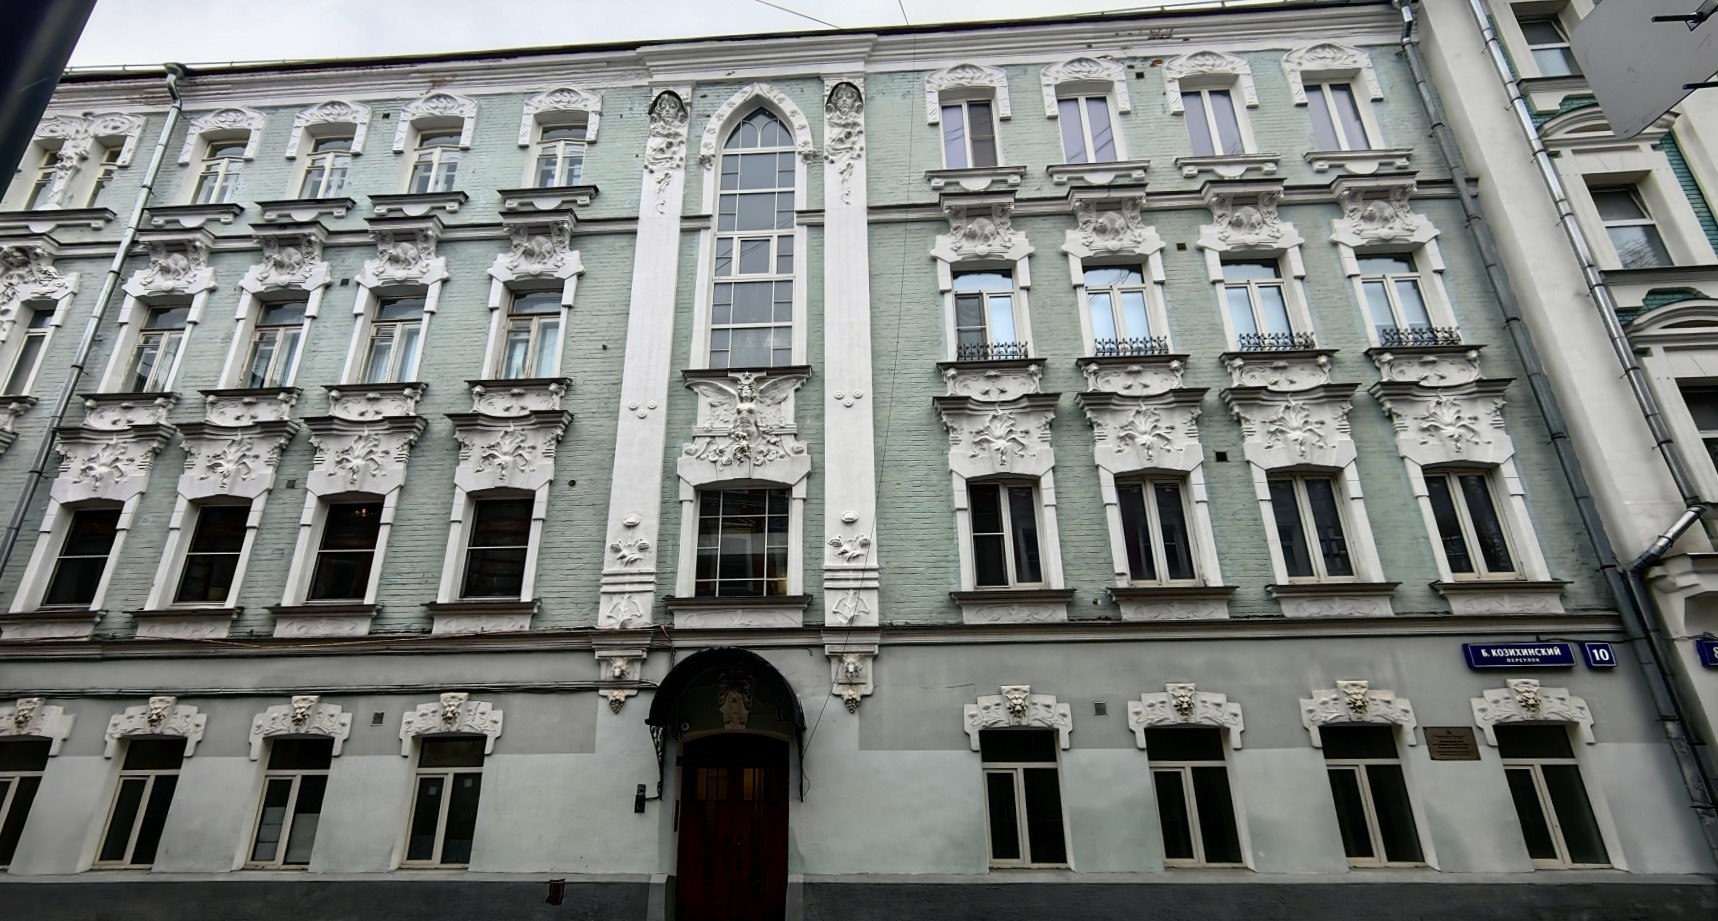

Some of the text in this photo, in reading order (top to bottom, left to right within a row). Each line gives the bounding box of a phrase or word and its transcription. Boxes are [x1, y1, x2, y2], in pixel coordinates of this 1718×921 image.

[1481, 646, 1562, 657] Б. КОЗИХИНСКИЙ
[1592, 648, 1610, 661] 10
